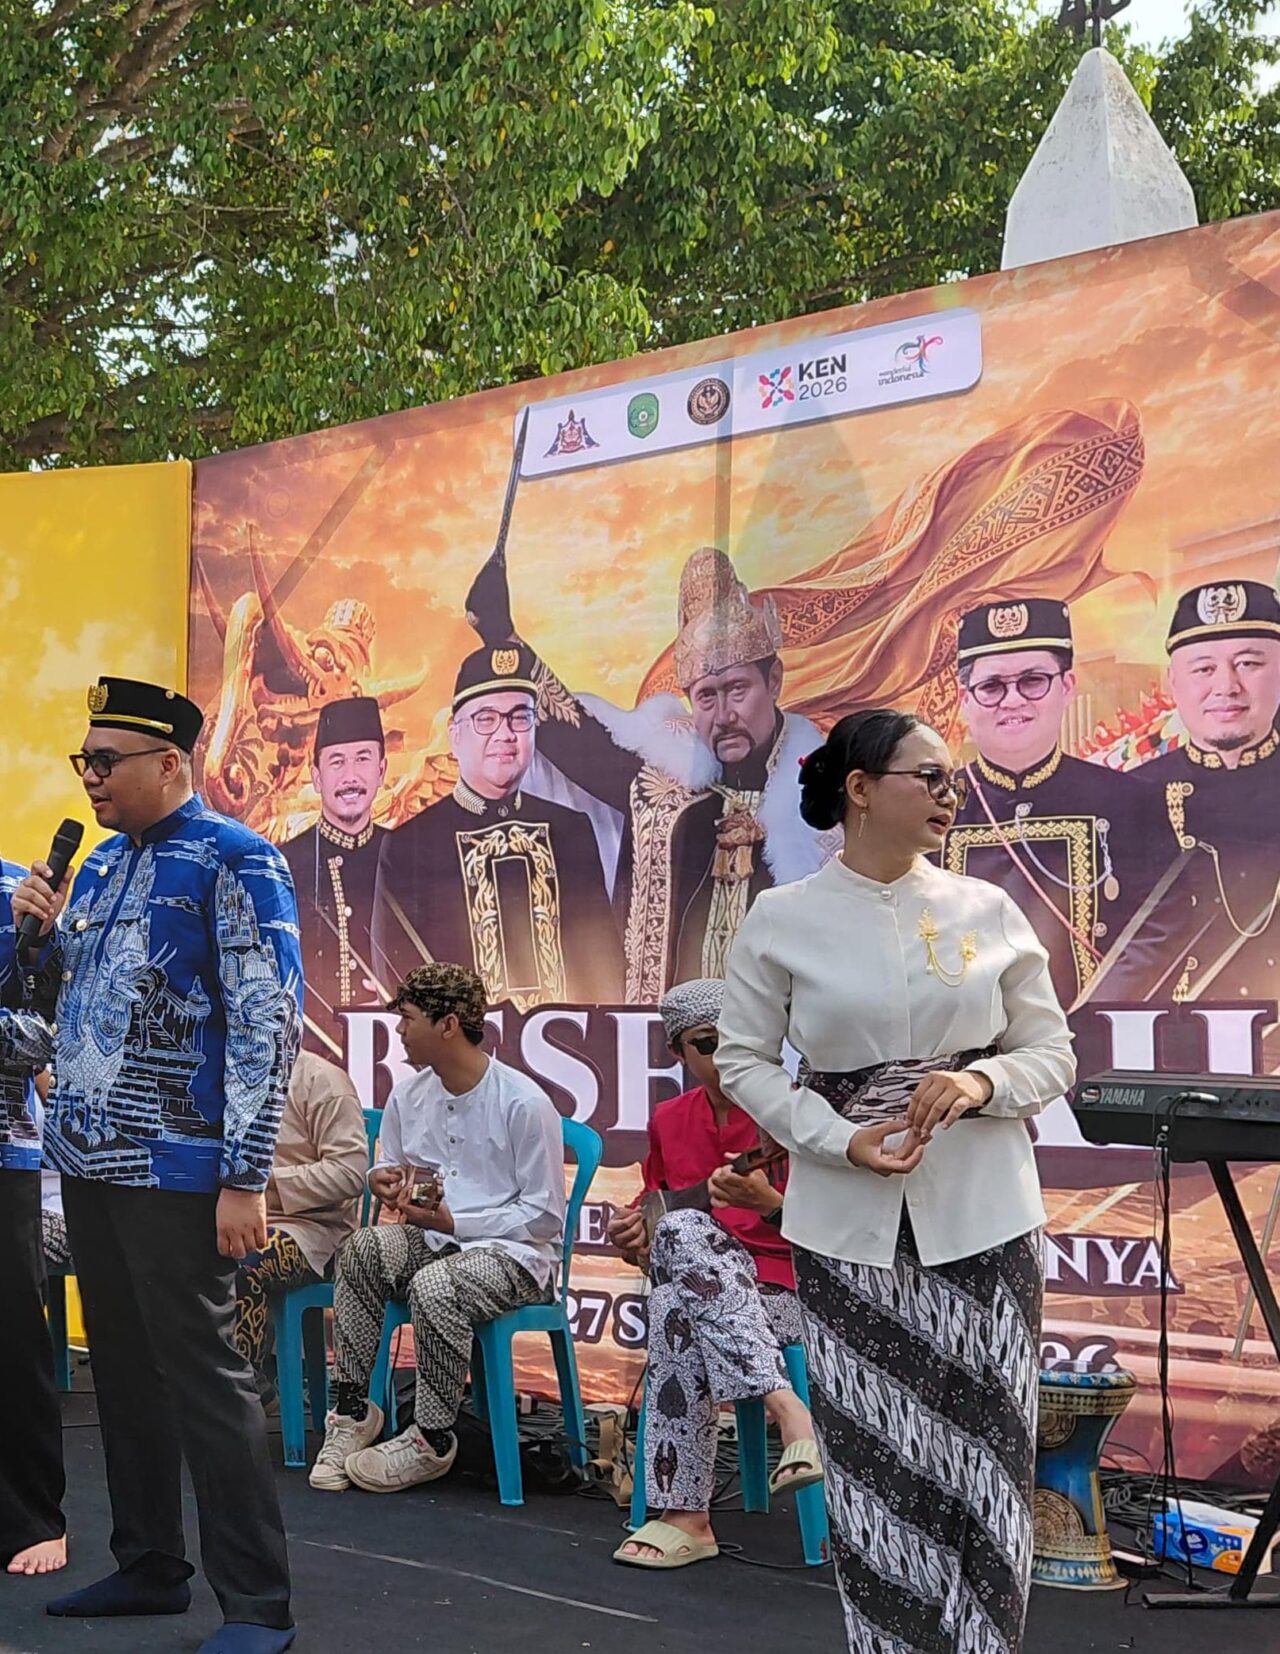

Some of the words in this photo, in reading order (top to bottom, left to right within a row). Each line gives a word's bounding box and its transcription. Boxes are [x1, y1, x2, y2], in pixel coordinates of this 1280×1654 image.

[798, 353, 847, 382] KEN
[799, 376, 848, 401] 2026
[877, 371, 925, 386] indonesia
[1099, 1088, 1146, 1106] YAMAHA
